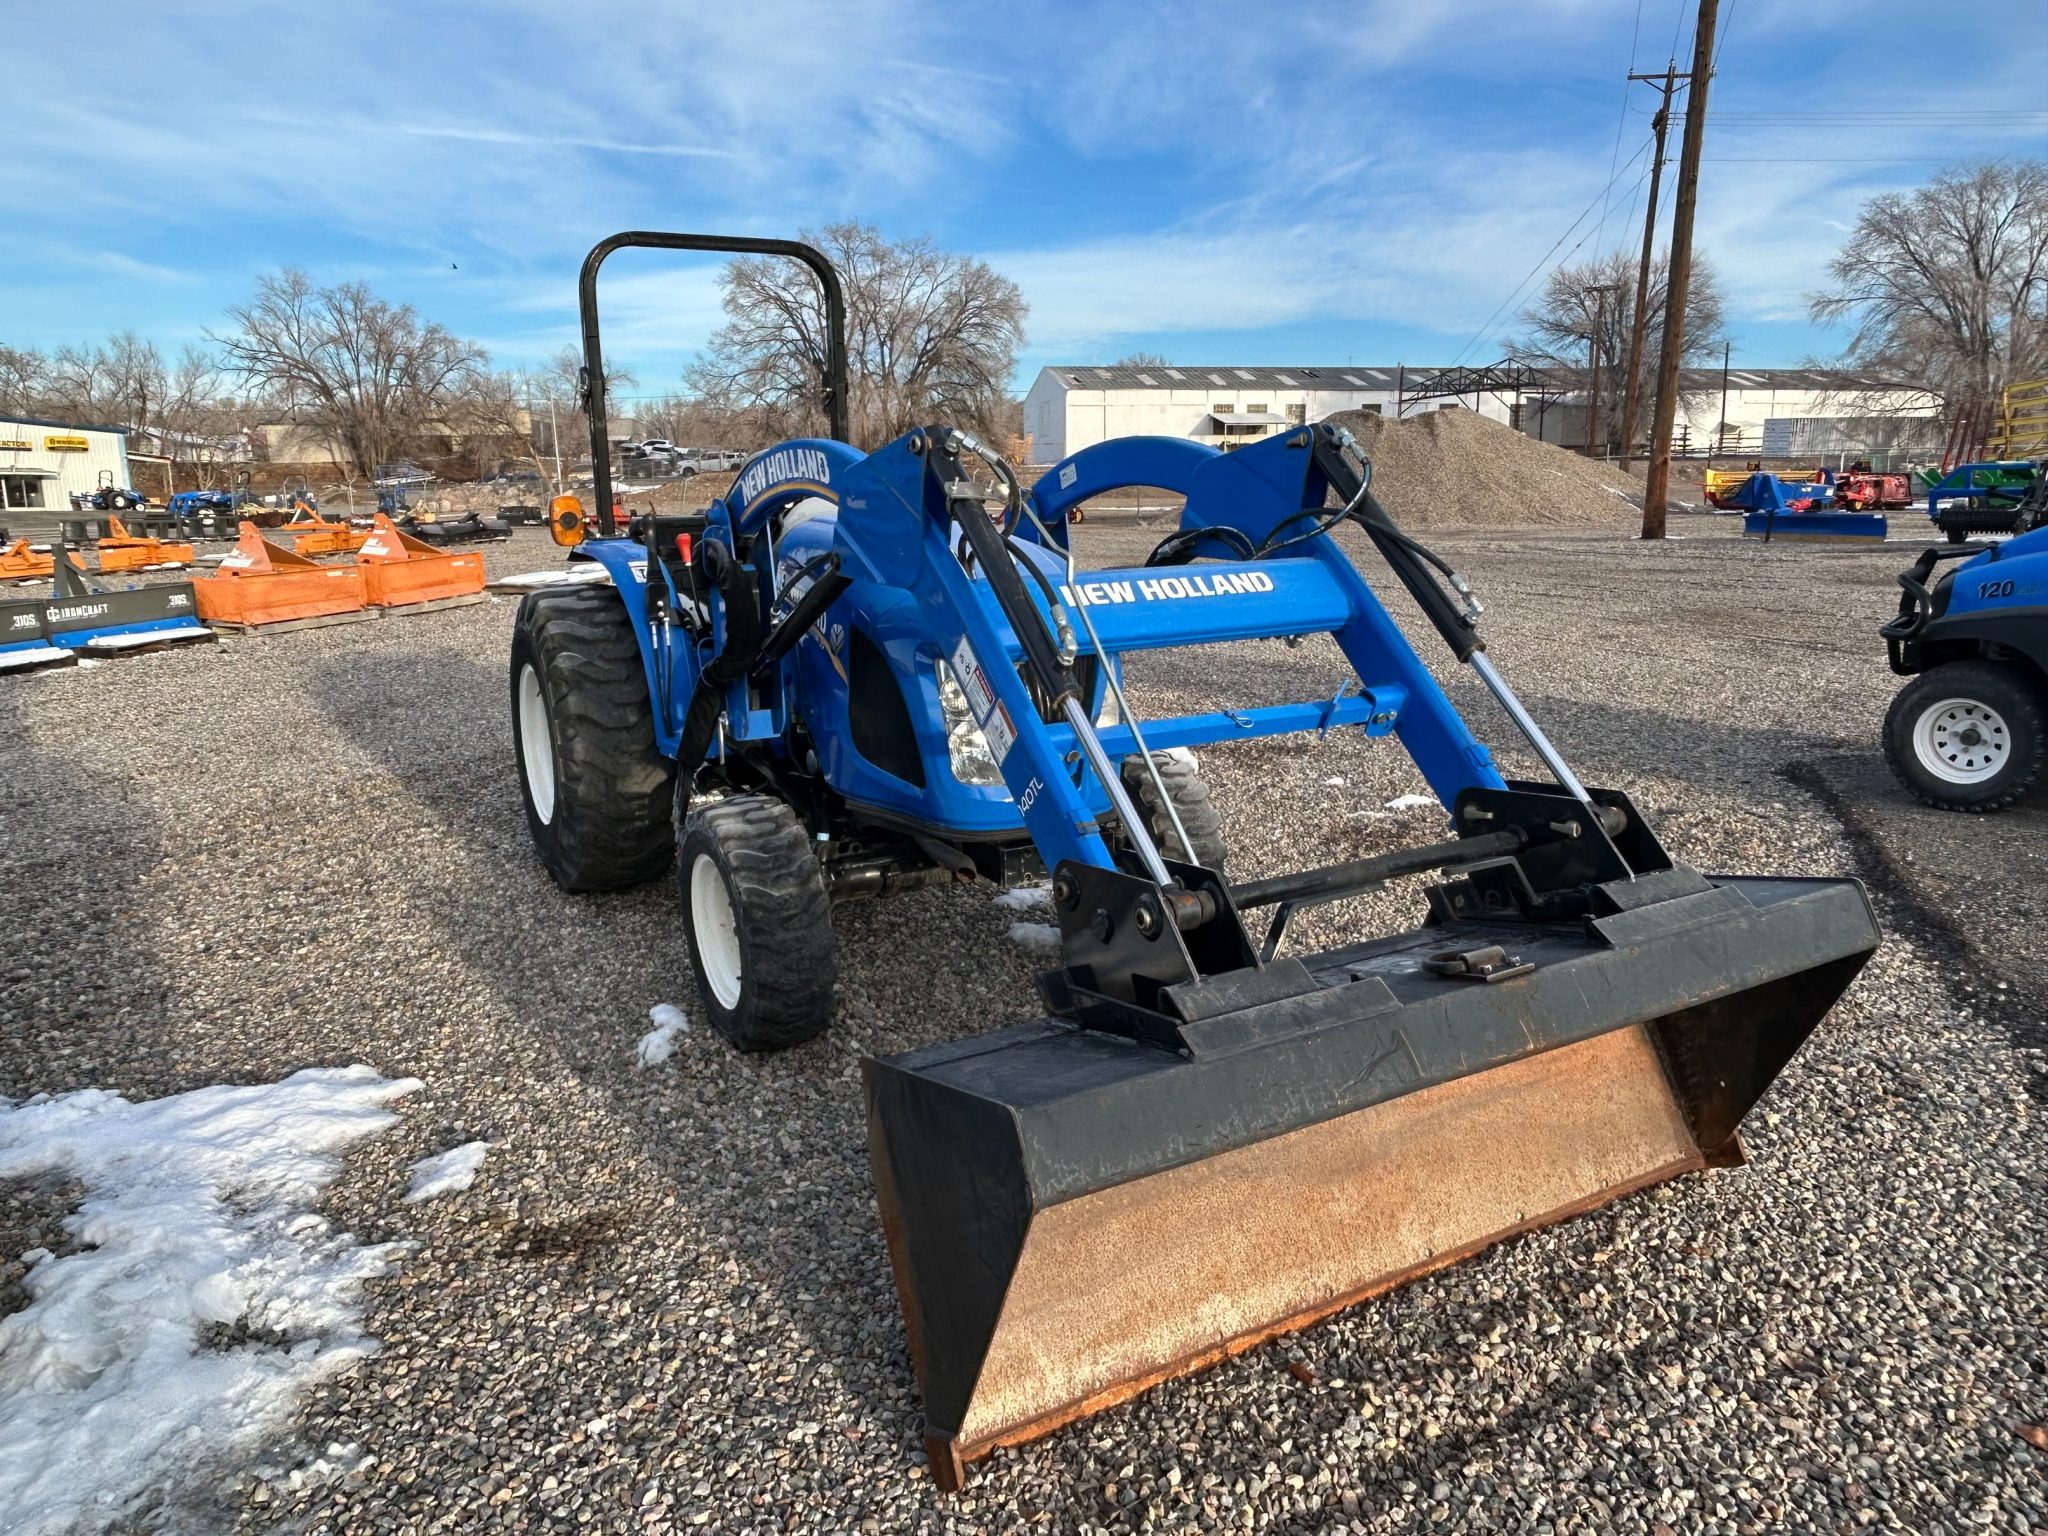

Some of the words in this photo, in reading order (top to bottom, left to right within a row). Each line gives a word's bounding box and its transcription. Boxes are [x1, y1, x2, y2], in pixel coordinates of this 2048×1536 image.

[741, 467, 766, 505] NEW
[768, 449, 830, 484] HOLLAND
[168, 594, 187, 606] 310S
[1060, 581, 1135, 607] NEW
[1137, 572, 1274, 600] HOLLAND
[1978, 579, 2015, 600] 120
[13, 614, 36, 628] 310S
